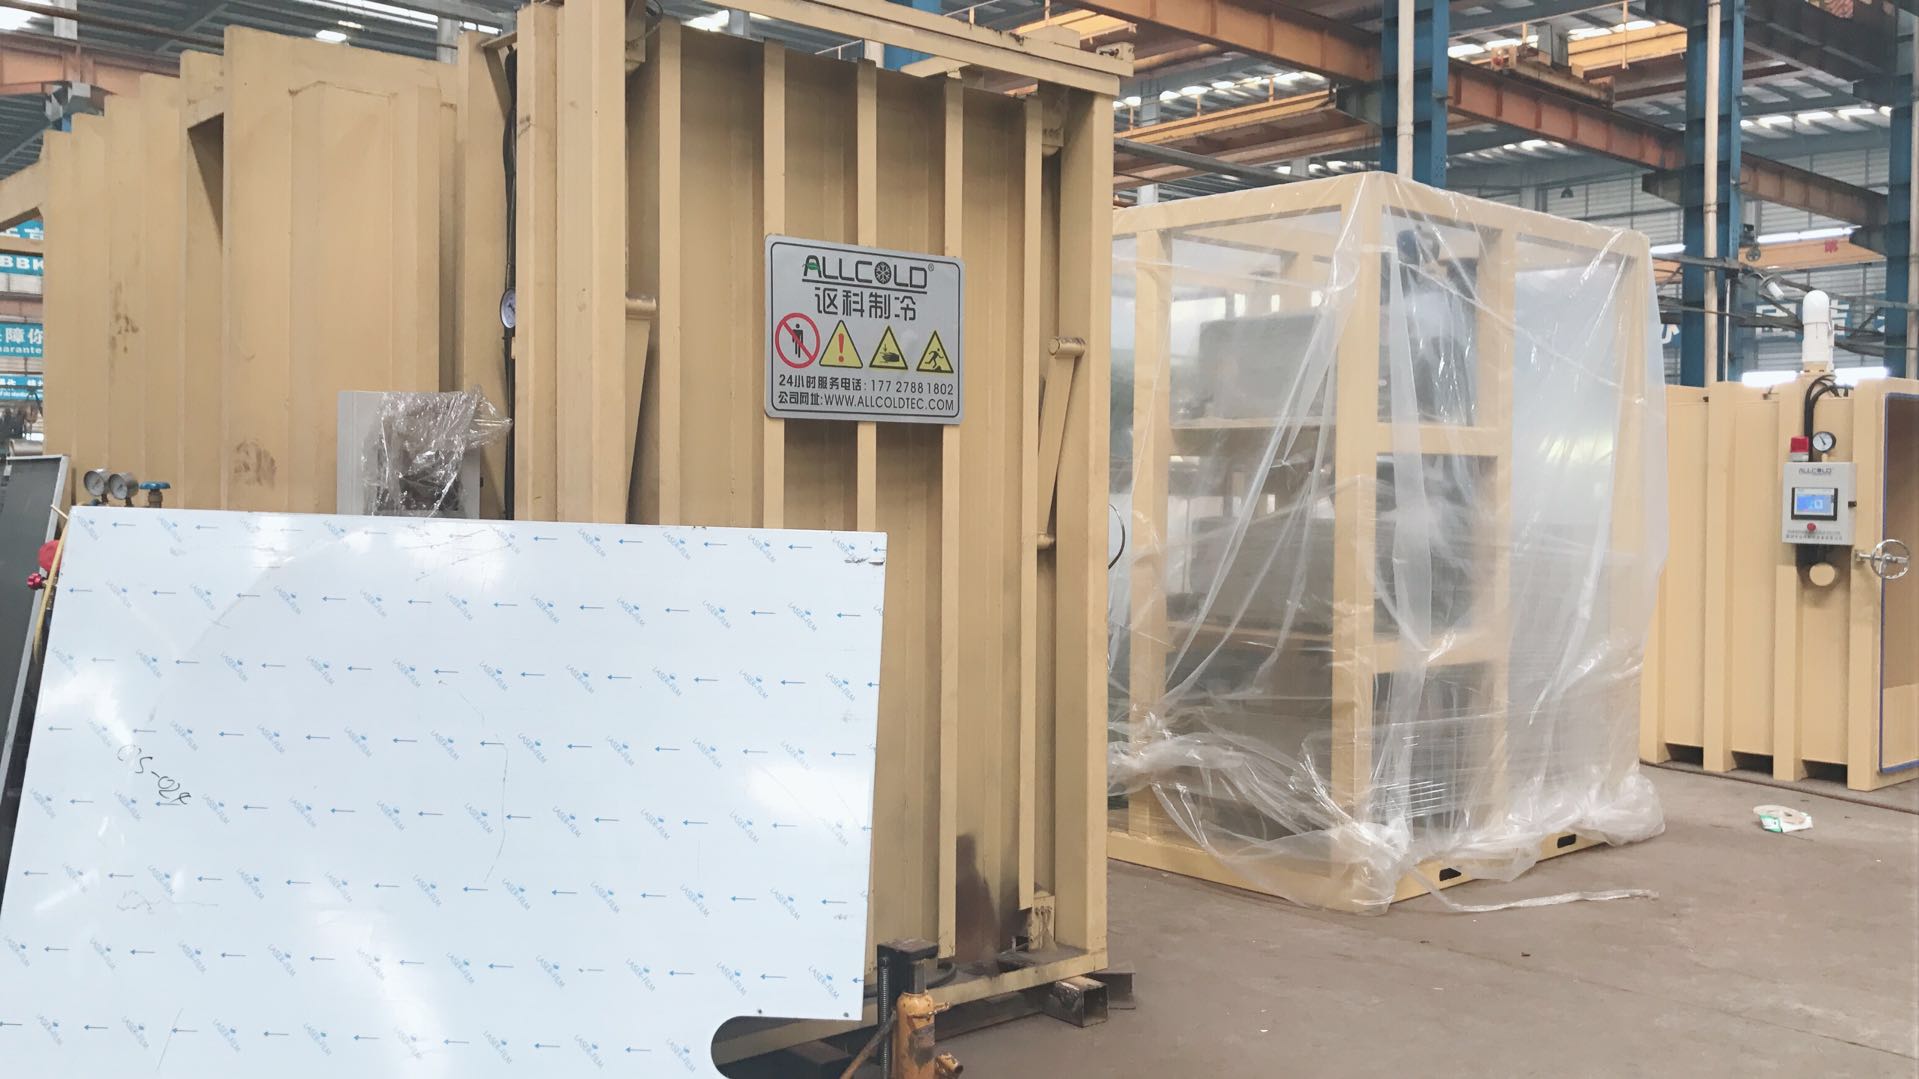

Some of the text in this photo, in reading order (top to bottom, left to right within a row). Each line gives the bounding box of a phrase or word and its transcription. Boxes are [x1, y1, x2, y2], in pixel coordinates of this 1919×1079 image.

[803, 255, 927, 289] ALLCOLD
[814, 286, 916, 321] 讴科制冷
[871, 379, 891, 392] 177
